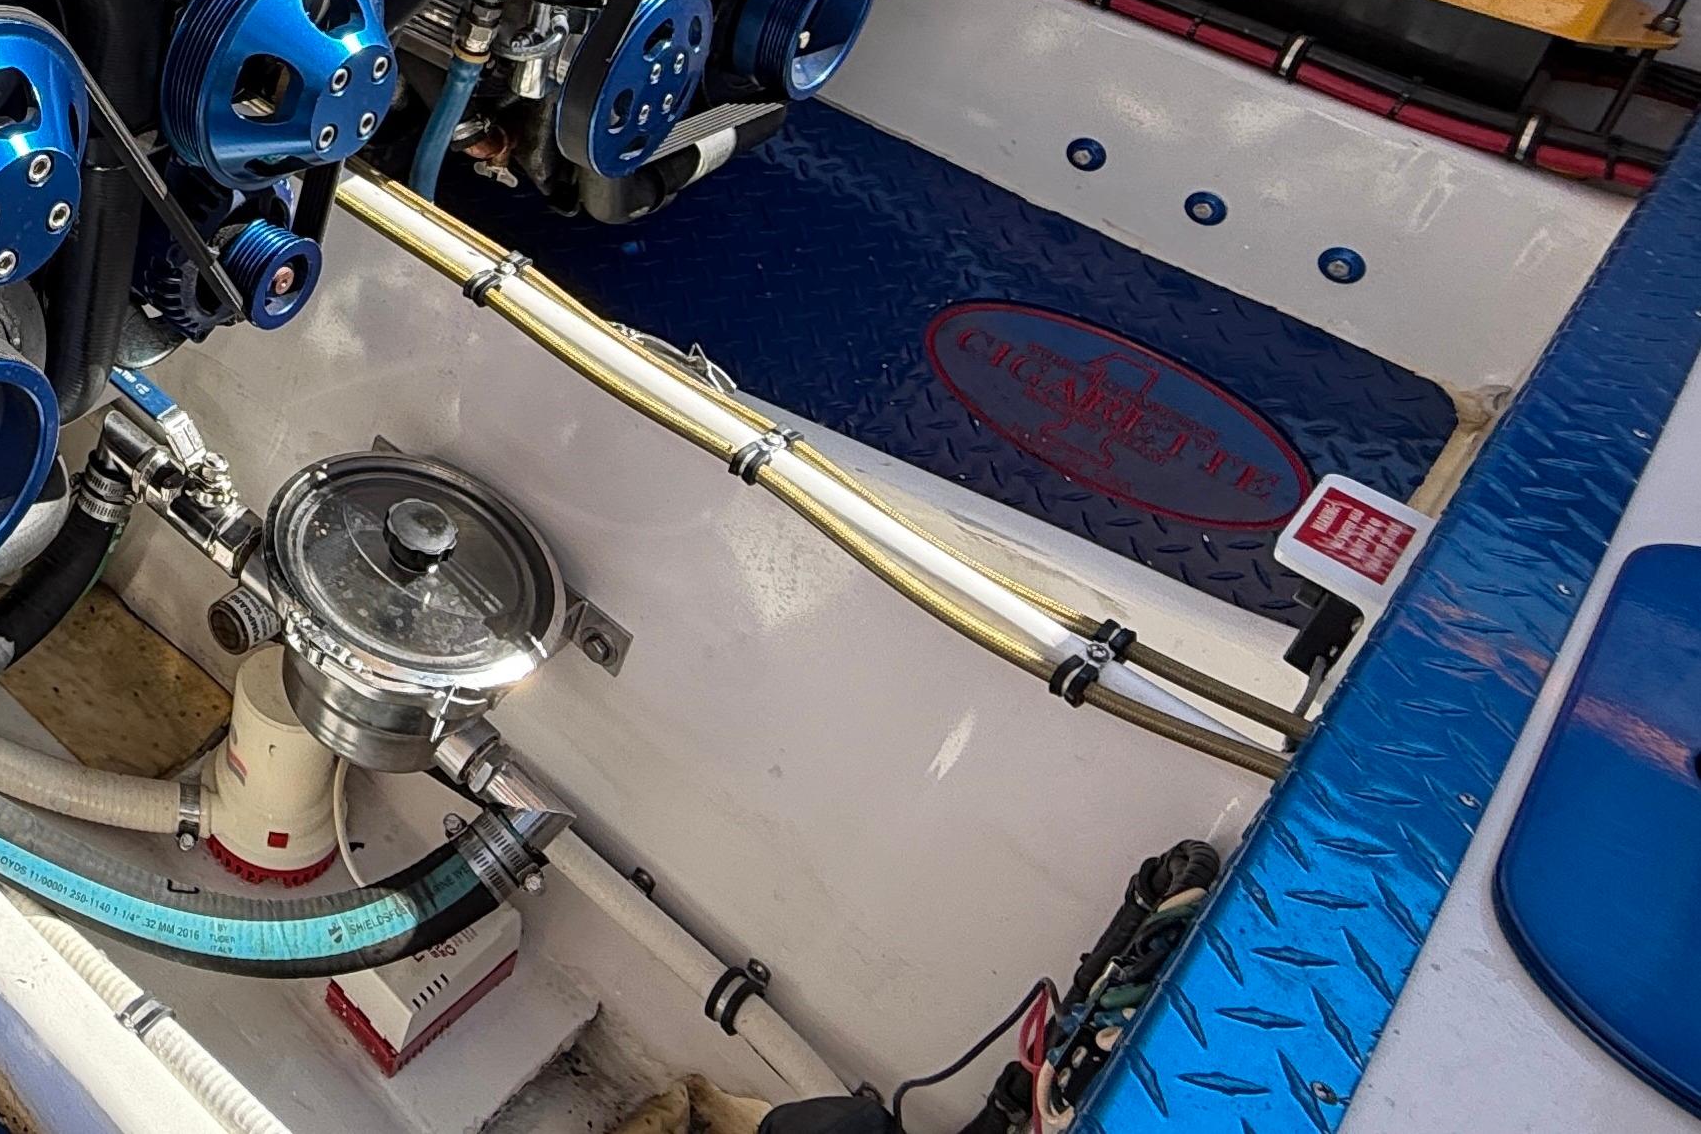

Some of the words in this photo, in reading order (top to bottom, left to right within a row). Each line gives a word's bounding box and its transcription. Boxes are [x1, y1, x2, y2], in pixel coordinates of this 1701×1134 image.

[957, 326, 1282, 506] CIGARETTE
[69, 888, 111, 914] 250-1140
[158, 923, 176, 935] MM
[176, 926, 200, 940] 2016
[210, 945, 234, 954] ITALY
